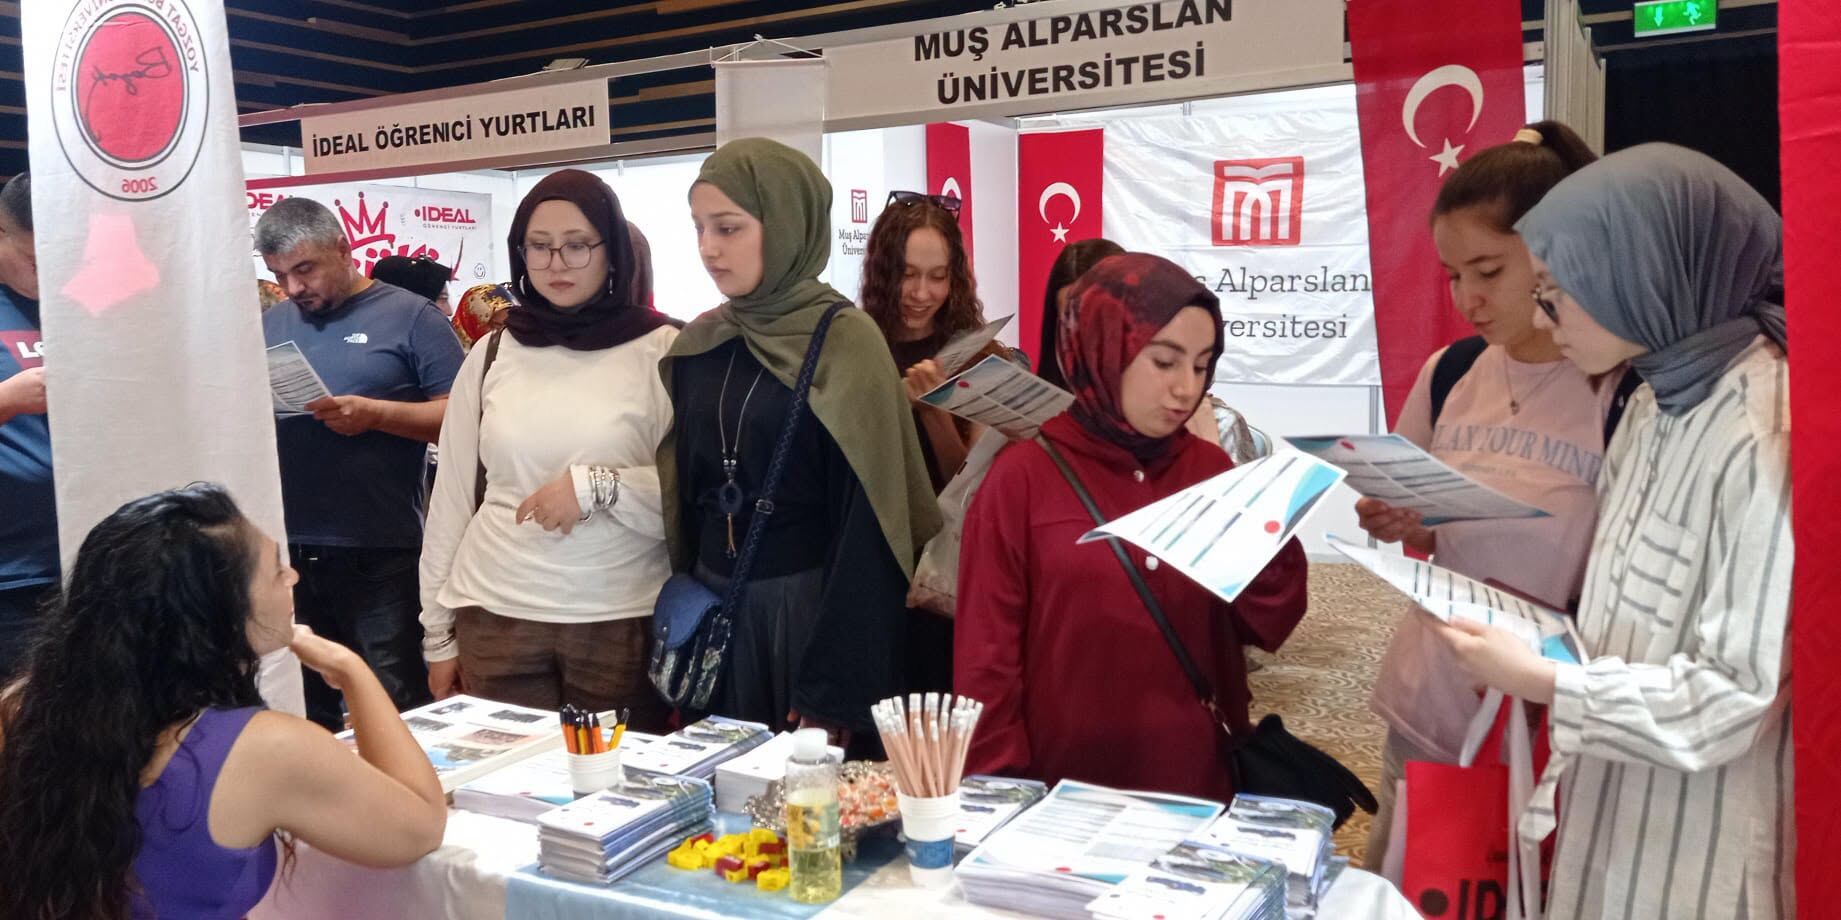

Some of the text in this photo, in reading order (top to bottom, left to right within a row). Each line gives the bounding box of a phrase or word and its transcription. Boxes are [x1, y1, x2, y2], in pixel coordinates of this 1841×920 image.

[914, 0, 1232, 62] MUŞ ALPARSLAN
[937, 41, 1205, 105] ÜNİVERSİTESİ
[312, 133, 369, 157] İDEAL
[479, 105, 595, 138] YURTLARI
[422, 206, 476, 223] IDEAL
[838, 229, 852, 243] Muş
[1215, 266, 1371, 300] Alparslan
[1433, 425, 1479, 451] LAX
[1479, 425, 1537, 460] YOUR
